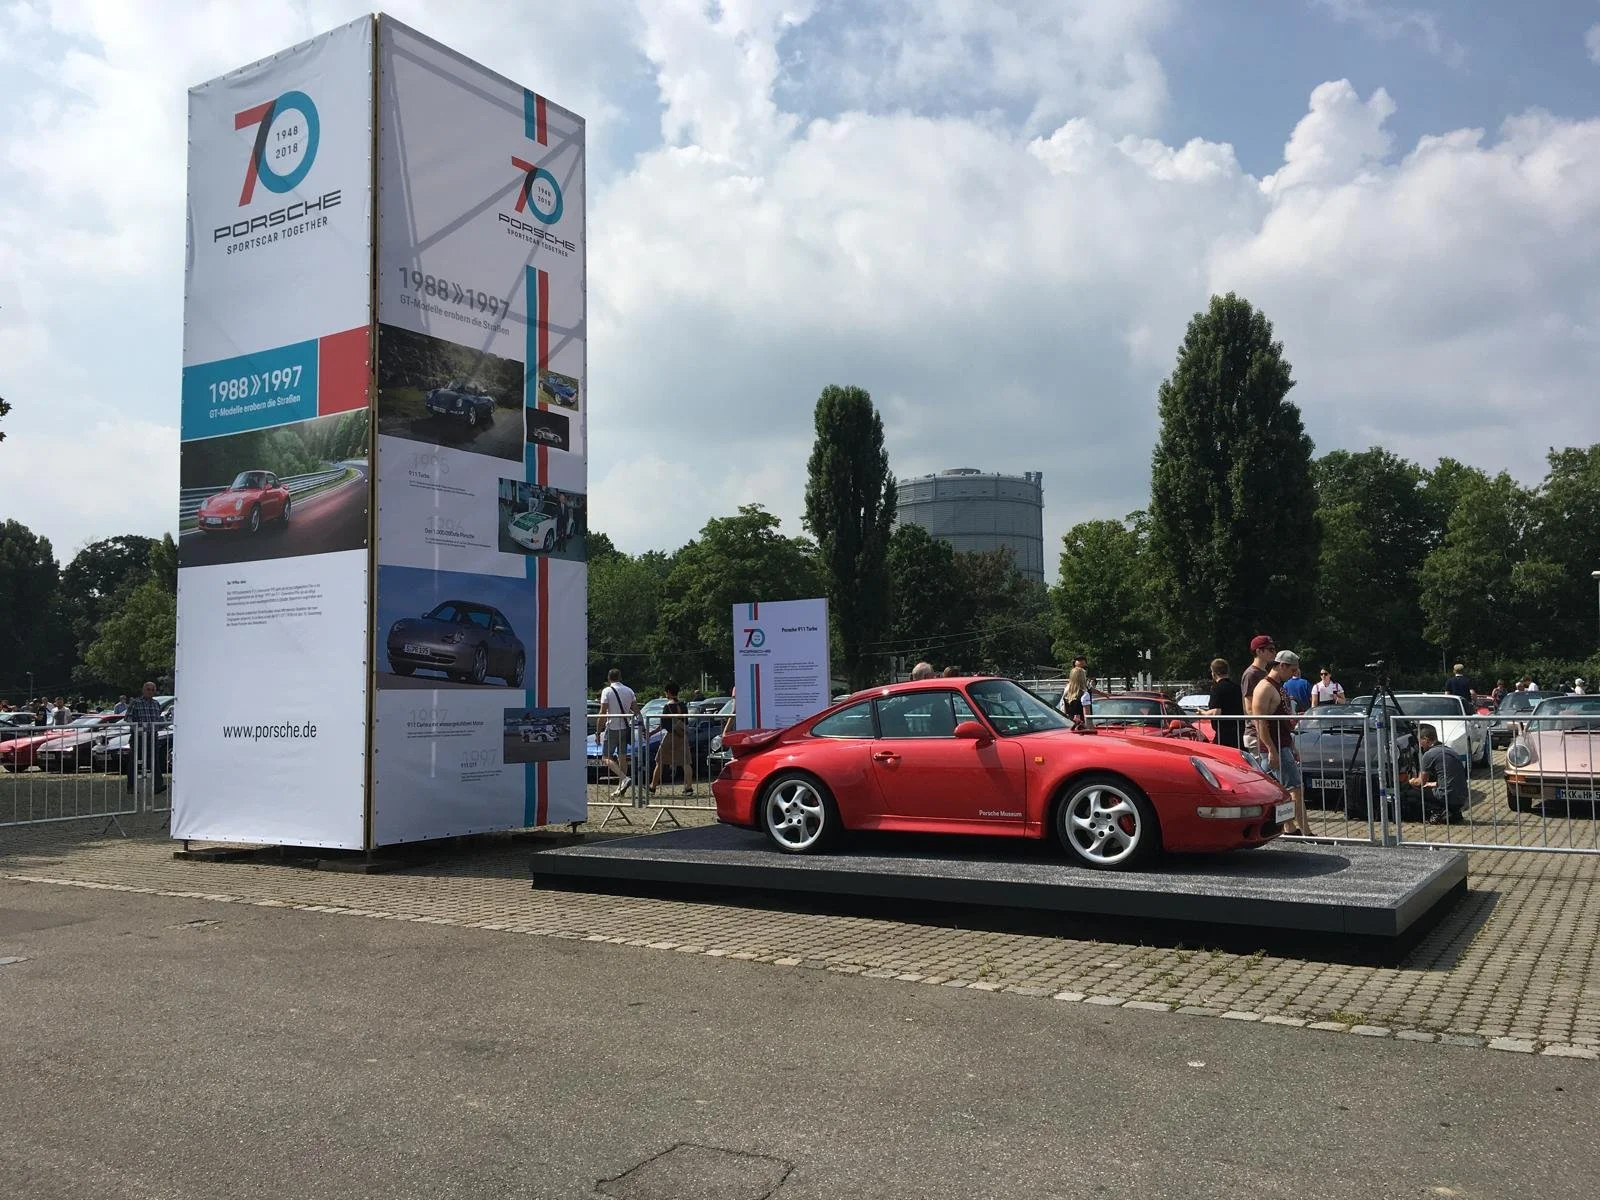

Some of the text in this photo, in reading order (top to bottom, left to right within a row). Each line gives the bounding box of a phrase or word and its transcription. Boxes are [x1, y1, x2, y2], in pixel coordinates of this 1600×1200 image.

[234, 91, 320, 207] 70
[276, 126, 299, 142] 1948
[275, 143, 298, 159] 2018
[511, 155, 564, 225] 70
[214, 189, 342, 243] PORSCHE
[226, 216, 328, 255] SPORTSCAR TOGETHER
[498, 213, 576, 252] PORSCHE
[507, 228, 569, 258] SPORTSCAR TOGETHER
[400, 294, 443, 316] GT-Modelle
[443, 309, 471, 324] erobern
[471, 317, 482, 328] die
[209, 405, 243, 419] GT-Modelle
[244, 401, 267, 413] erobern
[267, 398, 277, 409] die
[744, 629, 766, 648] 70
[222, 720, 317, 742] www.porsche.de
